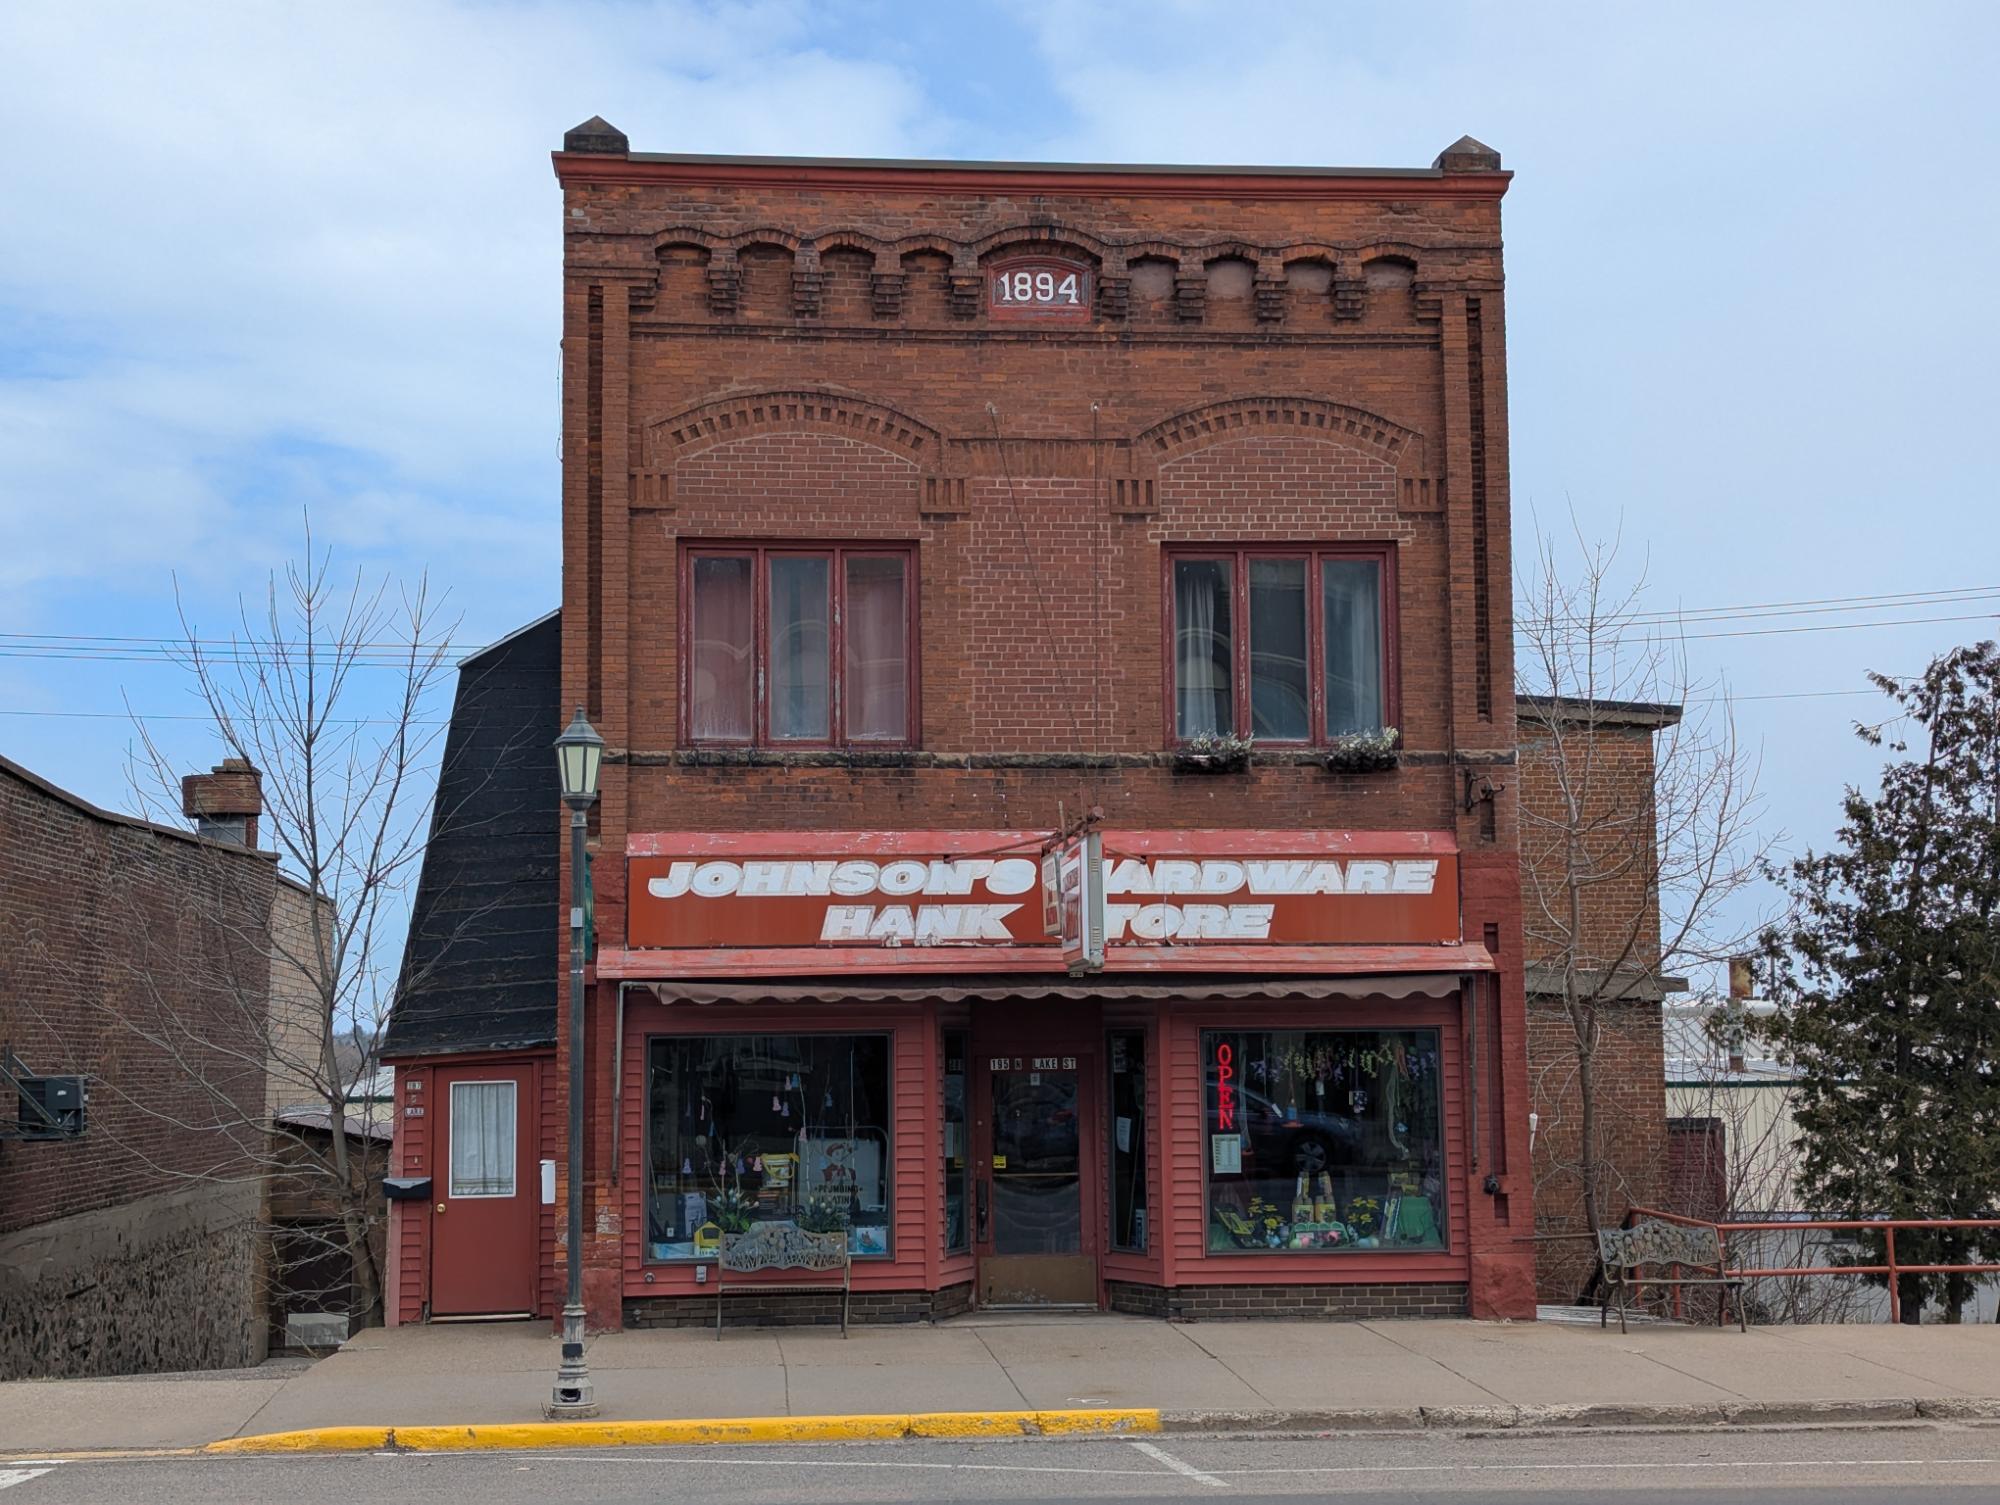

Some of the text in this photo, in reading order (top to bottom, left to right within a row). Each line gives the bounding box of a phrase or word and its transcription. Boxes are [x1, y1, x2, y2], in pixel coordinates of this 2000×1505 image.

[1000, 272, 1079, 304] 1894
[648, 859, 1037, 898] JOHNSON'S
[1102, 859, 1439, 895] ARDWARE
[821, 903, 1025, 941] HANK
[1103, 903, 1275, 940] TORE
[991, 1059, 1009, 1070] 195
[1032, 1058, 1057, 1069] LAKE
[1063, 1058, 1076, 1069] ST
[1217, 1044, 1234, 1130] OPEN
